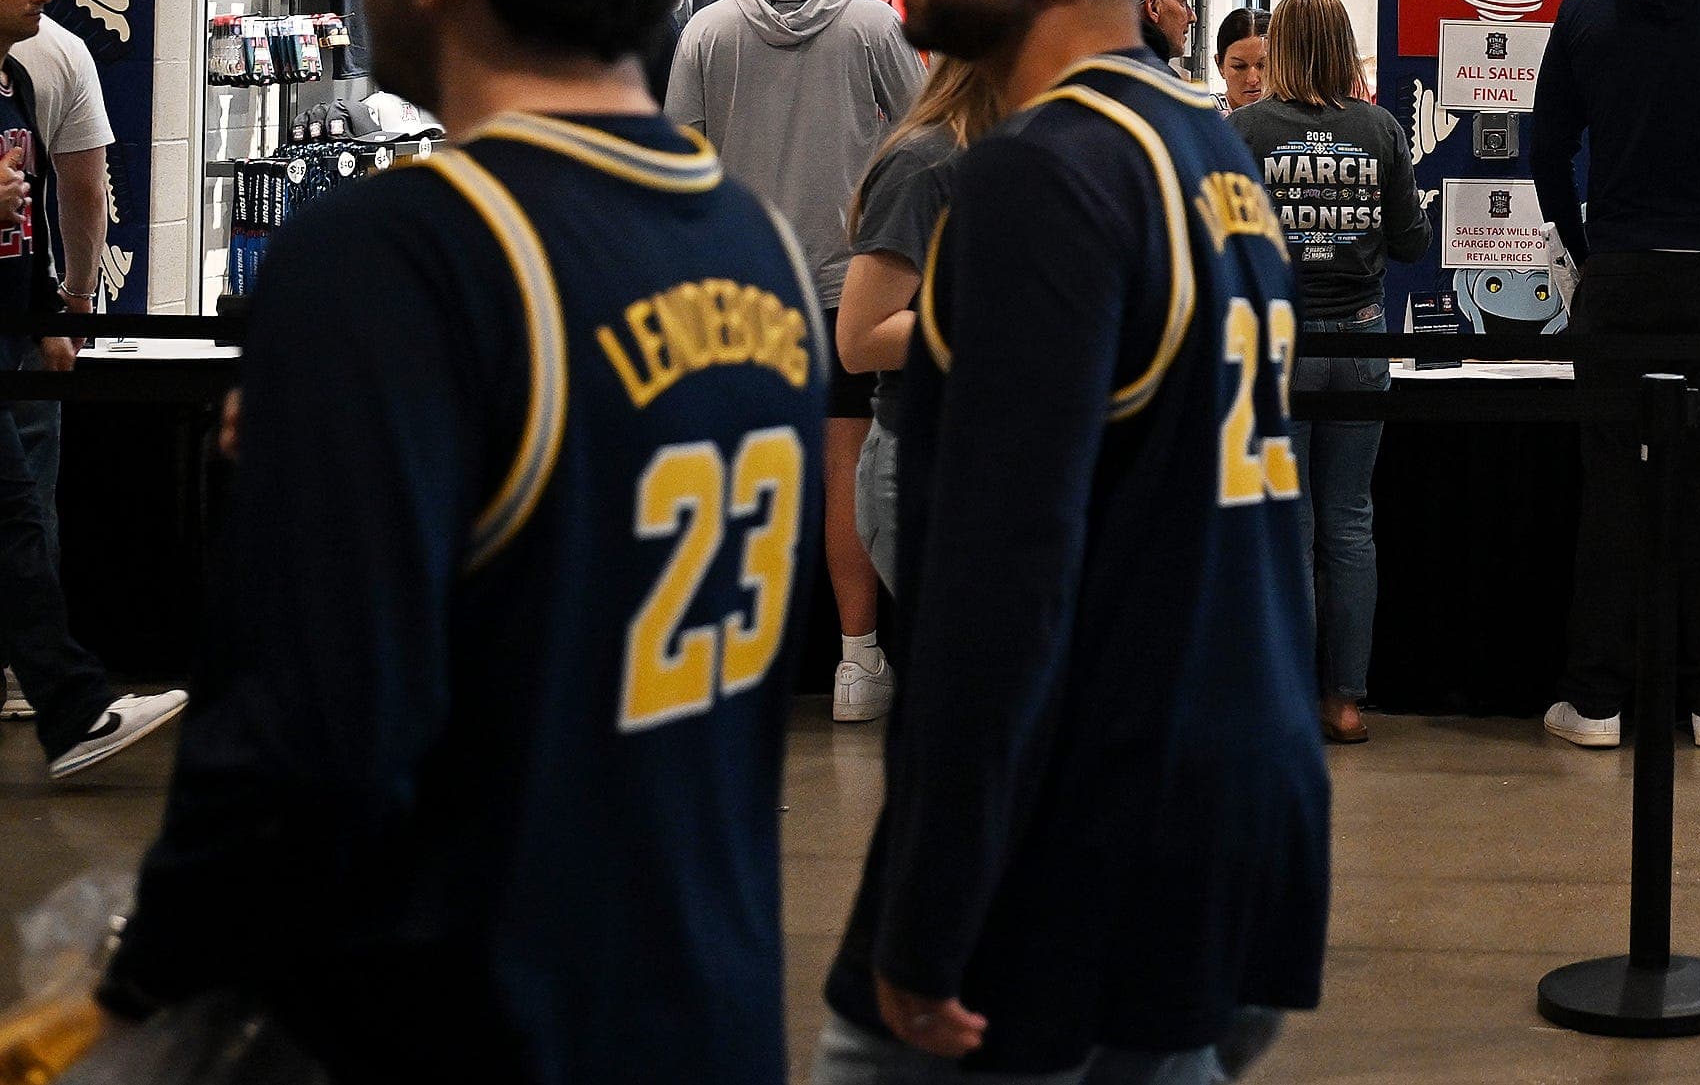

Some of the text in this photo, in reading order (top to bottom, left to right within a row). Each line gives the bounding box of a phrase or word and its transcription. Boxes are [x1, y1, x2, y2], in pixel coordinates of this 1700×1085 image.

[1456, 66, 1536, 81] ALL SALES
[1473, 88, 1518, 102] FINAL
[1306, 130, 1333, 142] 2024
[289, 164, 305, 176] $15
[1264, 155, 1378, 186] MARCH
[239, 196, 247, 221] FOUR
[274, 202, 282, 227] FOUR
[1281, 205, 1382, 230] ADNESS
[1456, 227, 1485, 236] SALES
[1486, 227, 1505, 236] TAX
[1506, 227, 1530, 236] WILL
[1451, 239, 1496, 249] CHARGED
[1498, 240, 1512, 249] ON
[1515, 240, 1534, 250] TOP
[1466, 252, 1533, 262] RETAIL PRICES
[615, 424, 805, 734] 23
